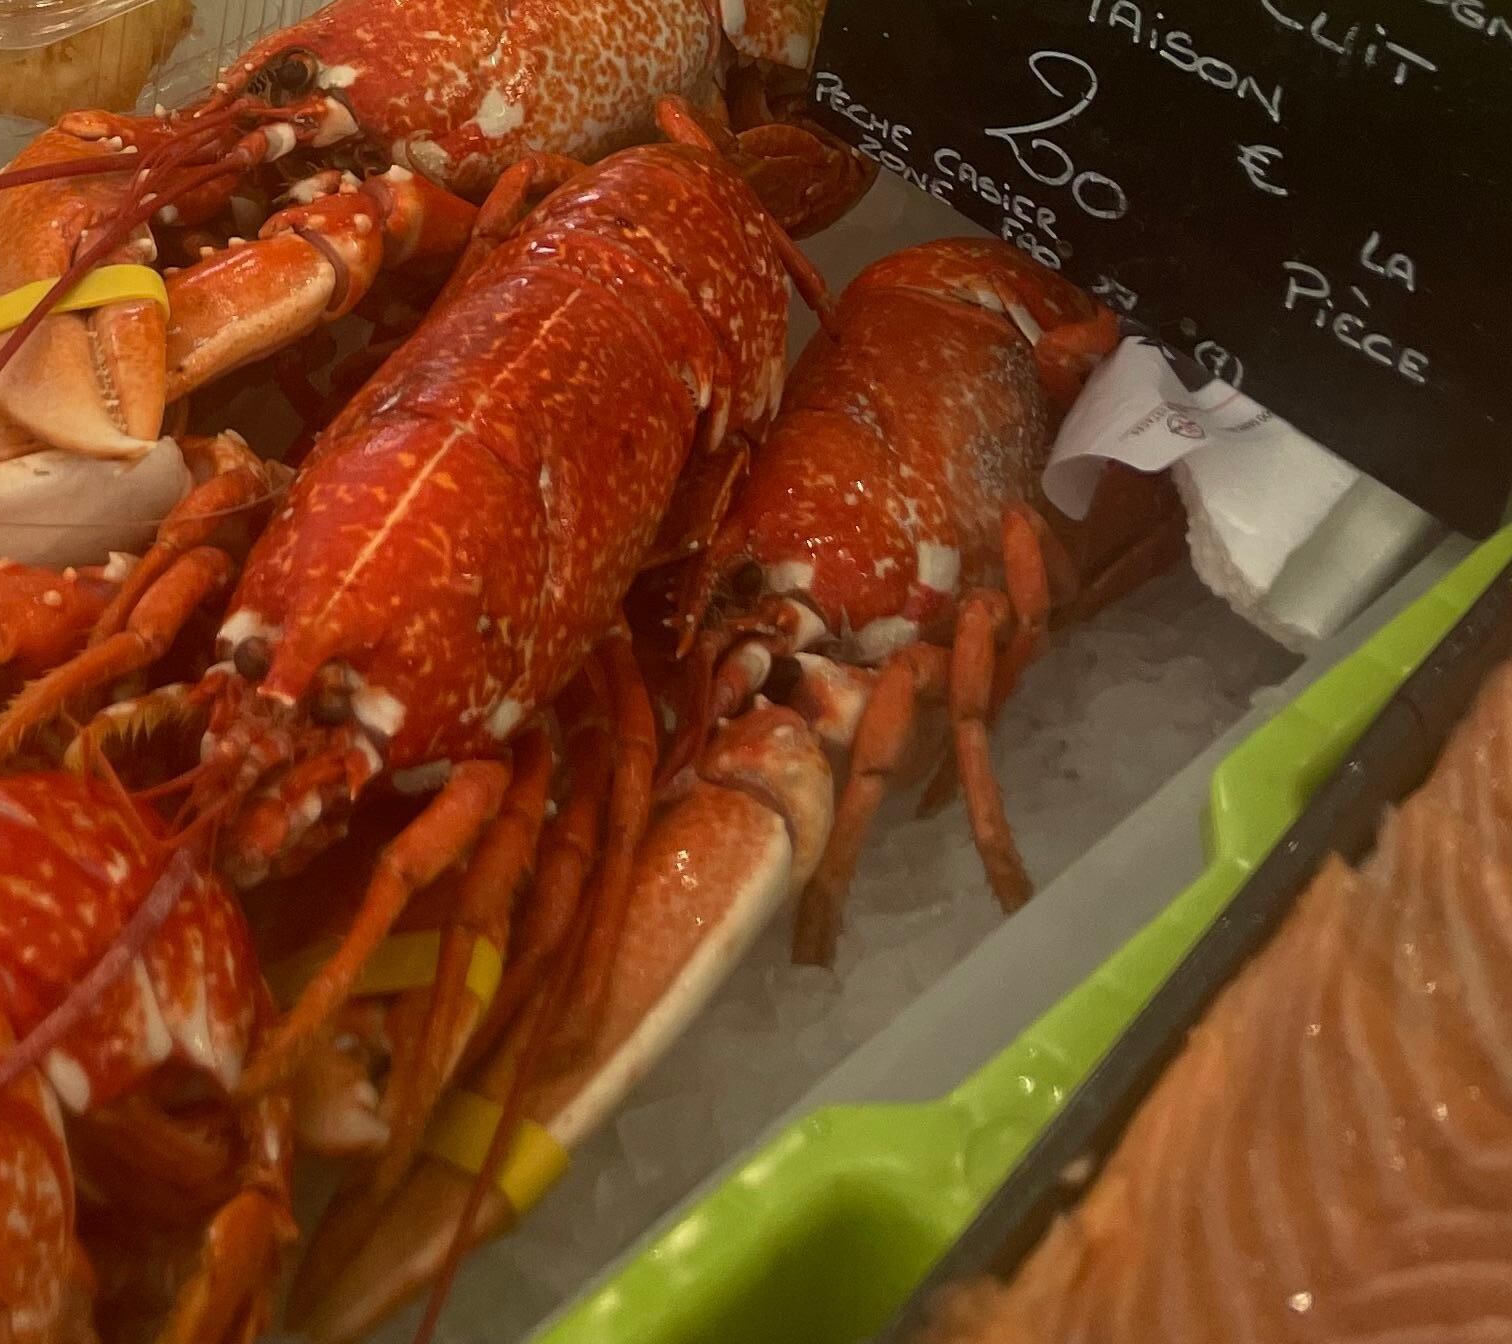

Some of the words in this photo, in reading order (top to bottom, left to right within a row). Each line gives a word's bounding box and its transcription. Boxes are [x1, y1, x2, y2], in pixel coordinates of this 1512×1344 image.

[814, 72, 912, 152] PECHE
[932, 148, 1067, 241] CASIER
[857, 135, 956, 207] ZONE
[984, 49, 1129, 220] 20
[1236, 143, 1289, 198] €
[1359, 230, 1416, 293] LA
